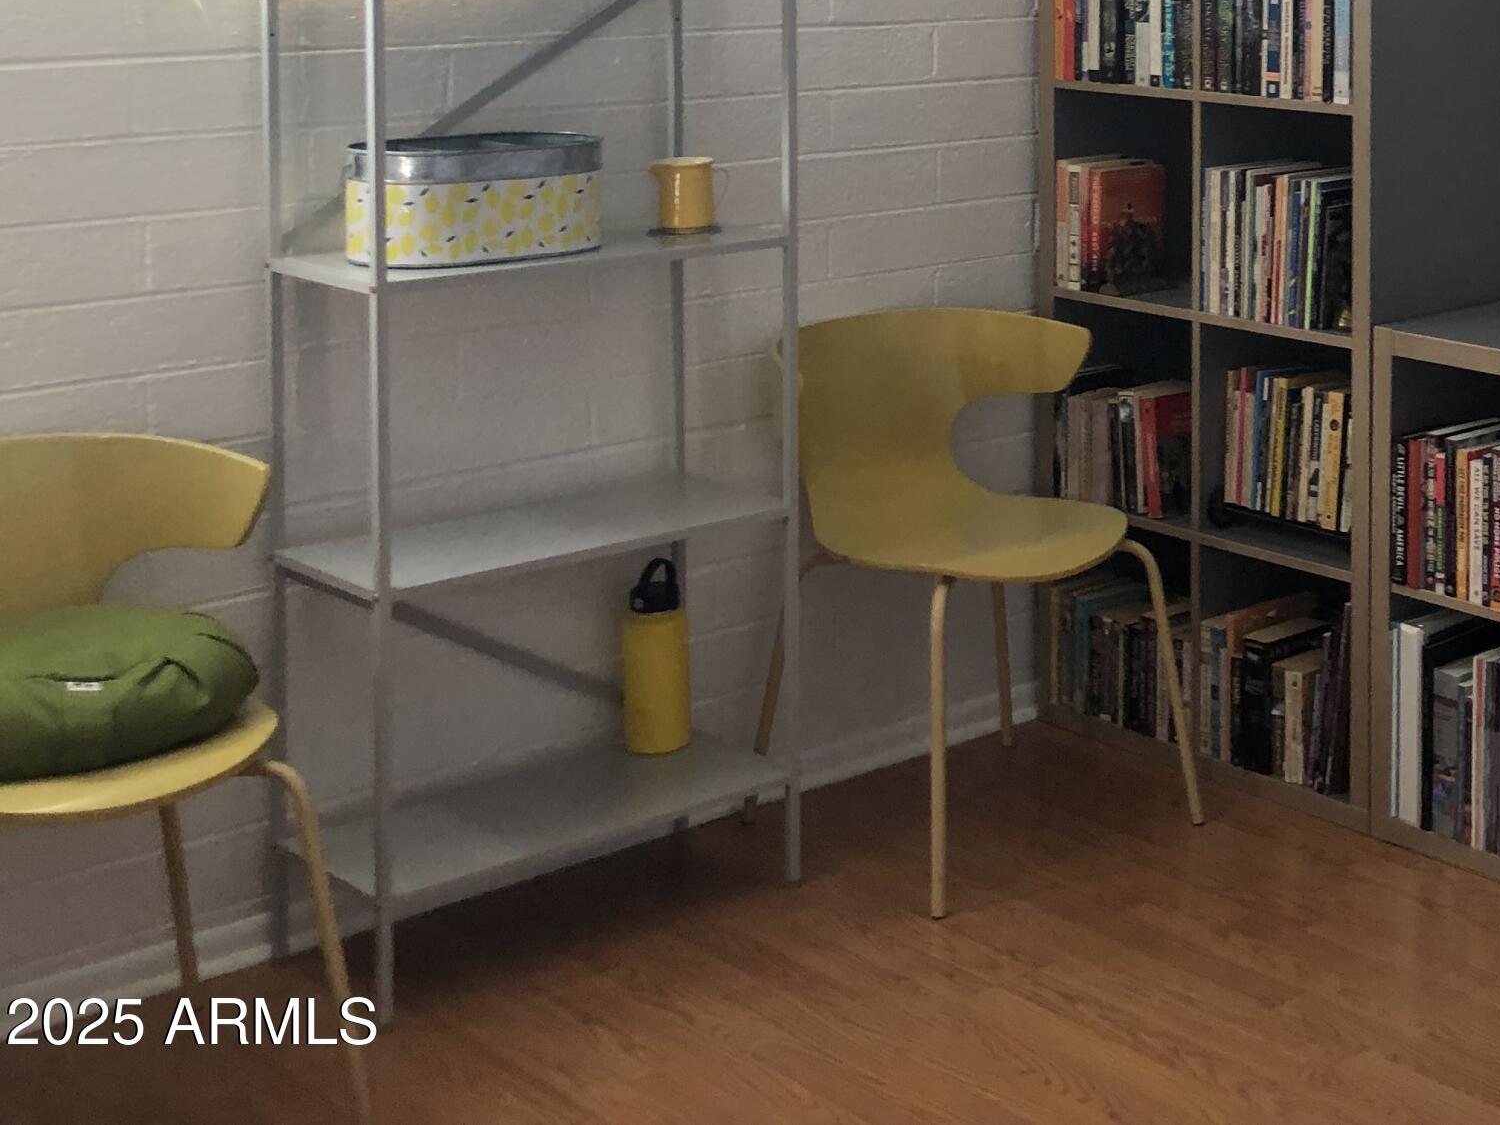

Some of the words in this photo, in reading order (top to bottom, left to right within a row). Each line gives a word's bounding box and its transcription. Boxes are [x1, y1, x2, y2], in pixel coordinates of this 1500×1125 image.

[1397, 457, 1405, 483] LITTLE
[1474, 487, 1480, 500] WE
[1494, 507, 1500, 520] NO
[1396, 528, 1404, 566] AMERICA
